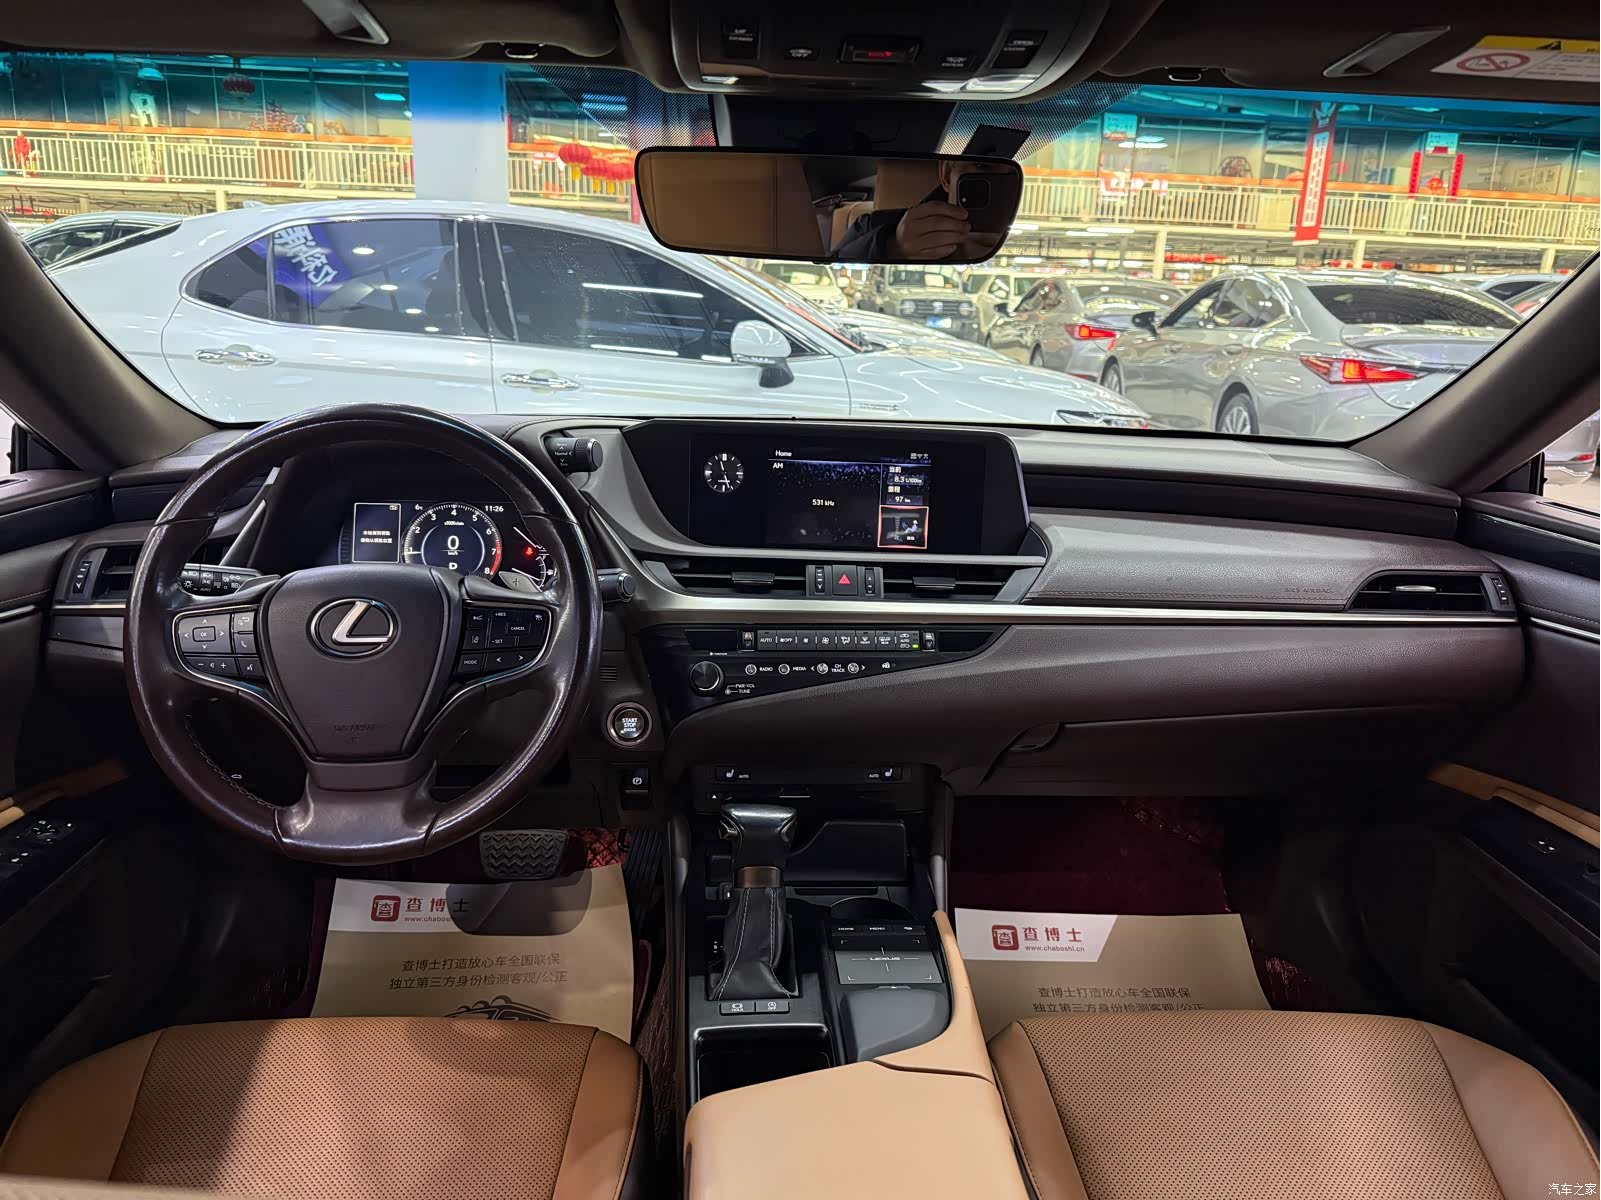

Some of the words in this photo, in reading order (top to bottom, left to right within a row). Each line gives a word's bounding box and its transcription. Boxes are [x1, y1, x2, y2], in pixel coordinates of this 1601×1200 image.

[415, 526, 421, 534] 2
[447, 535, 460, 550] 0
[484, 567, 490, 575] 8
[1022, 926, 1083, 942] 查博士
[1024, 944, 1085, 953] www.chaboshi.cn
[401, 953, 561, 972] 查博士打造放心车全国联保
[388, 970, 568, 991] 独立第三方身份检测客观/公正
[1037, 987, 1192, 999] 查博士打造放心车全国联保
